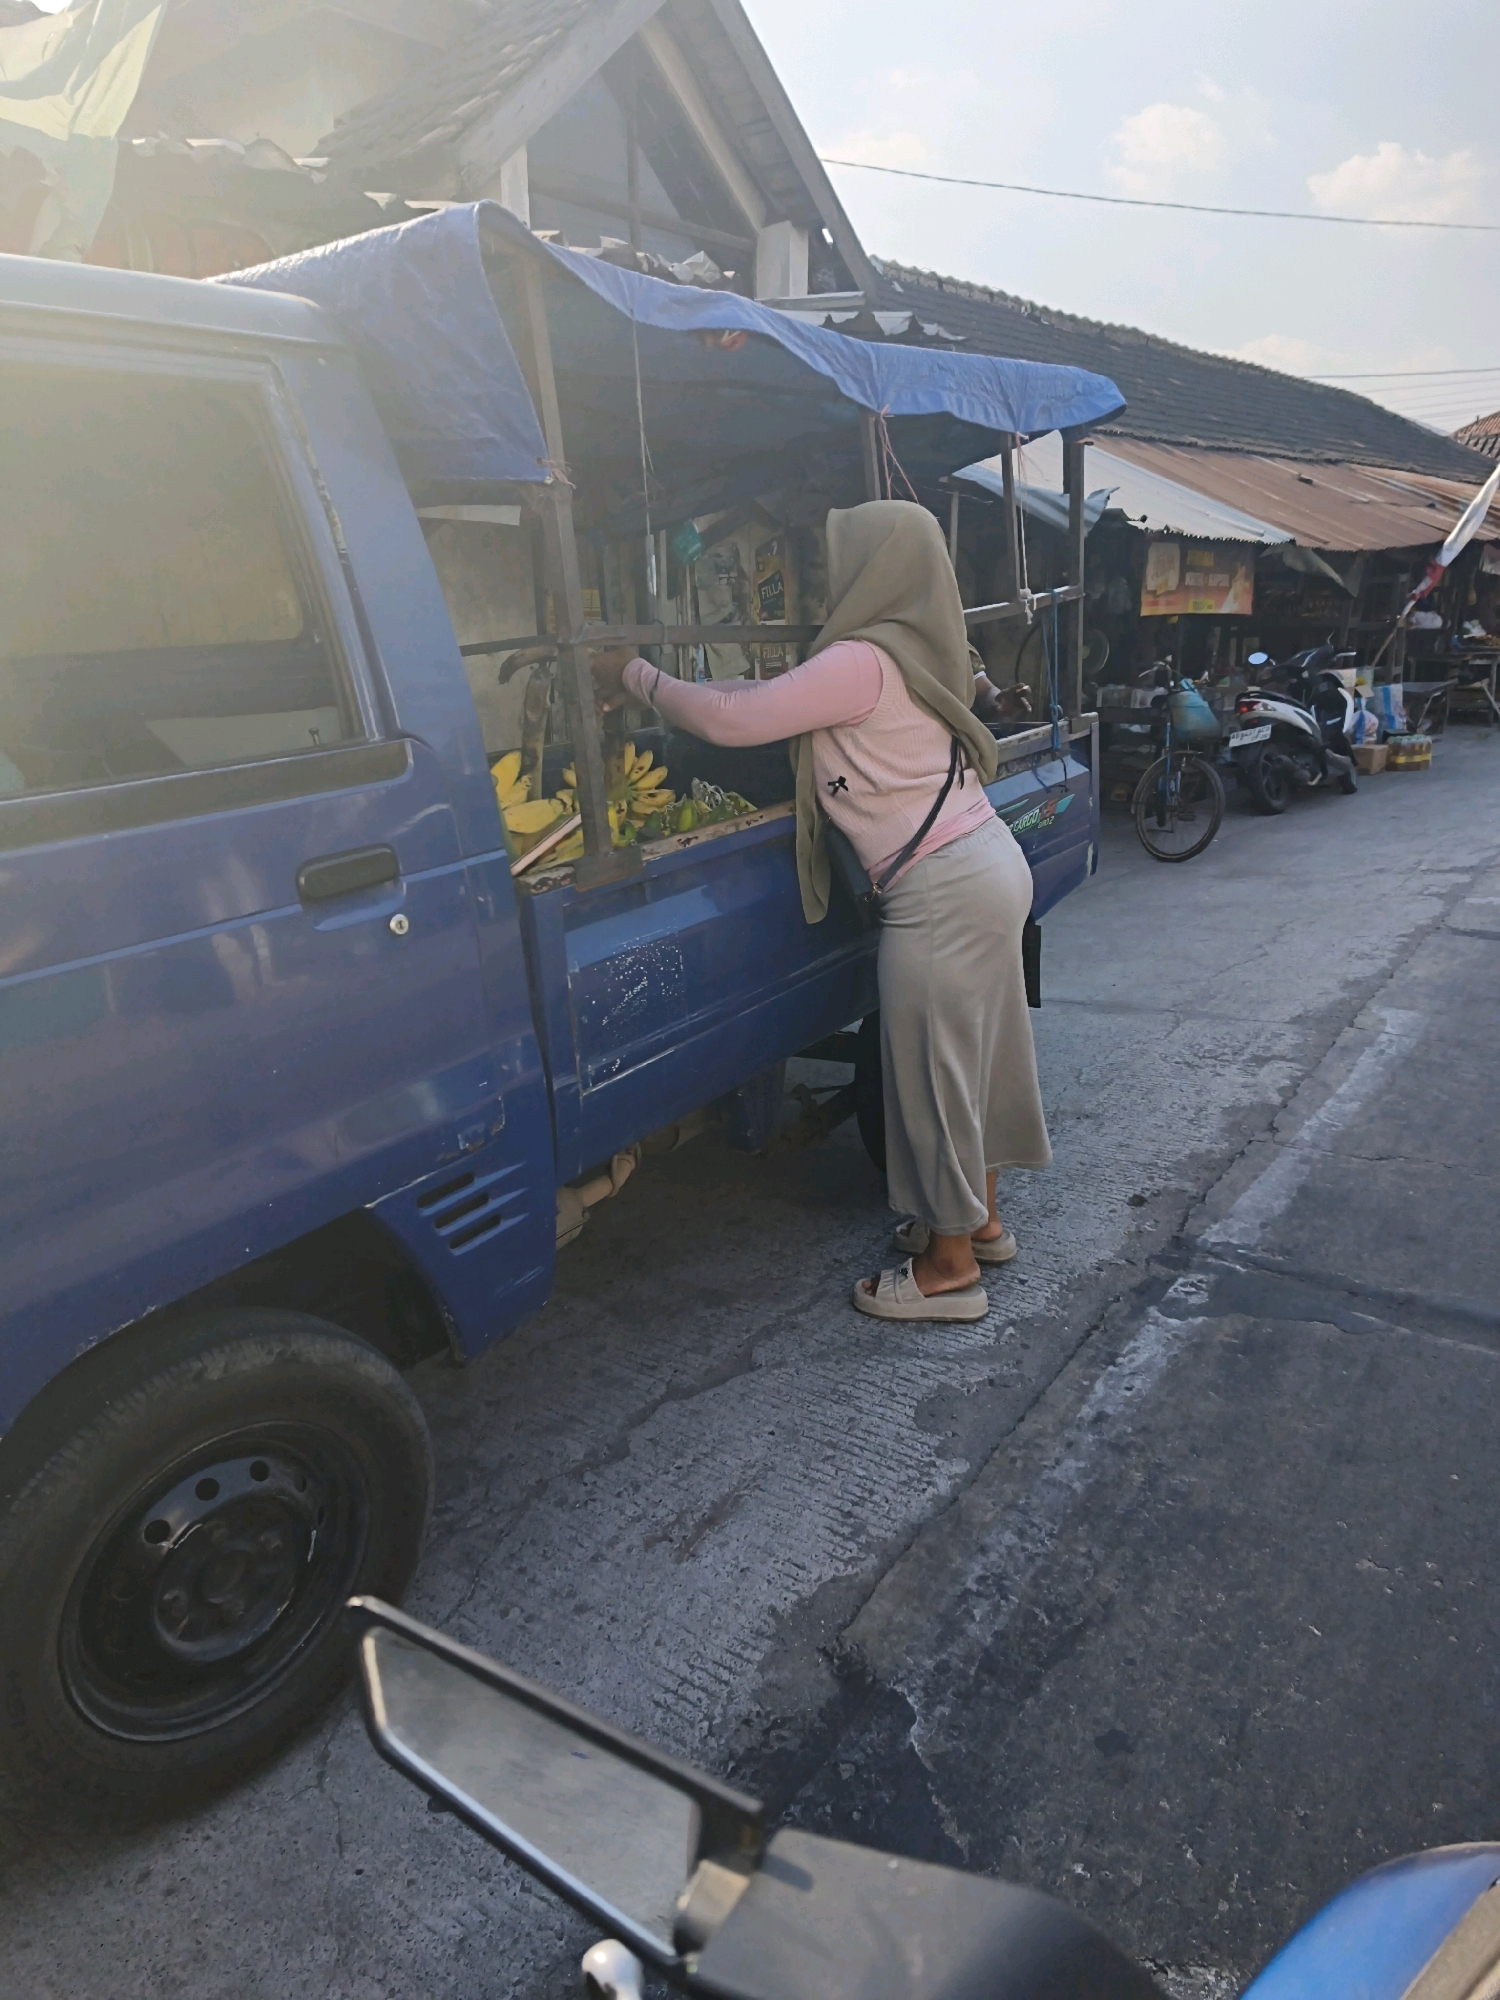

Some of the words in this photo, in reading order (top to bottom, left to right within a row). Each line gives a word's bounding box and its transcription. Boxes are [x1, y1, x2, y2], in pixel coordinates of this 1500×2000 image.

[761, 581, 783, 599] FILLA
[762, 646, 783, 658] FILLA
[1012, 808, 1040, 832] CARGO
